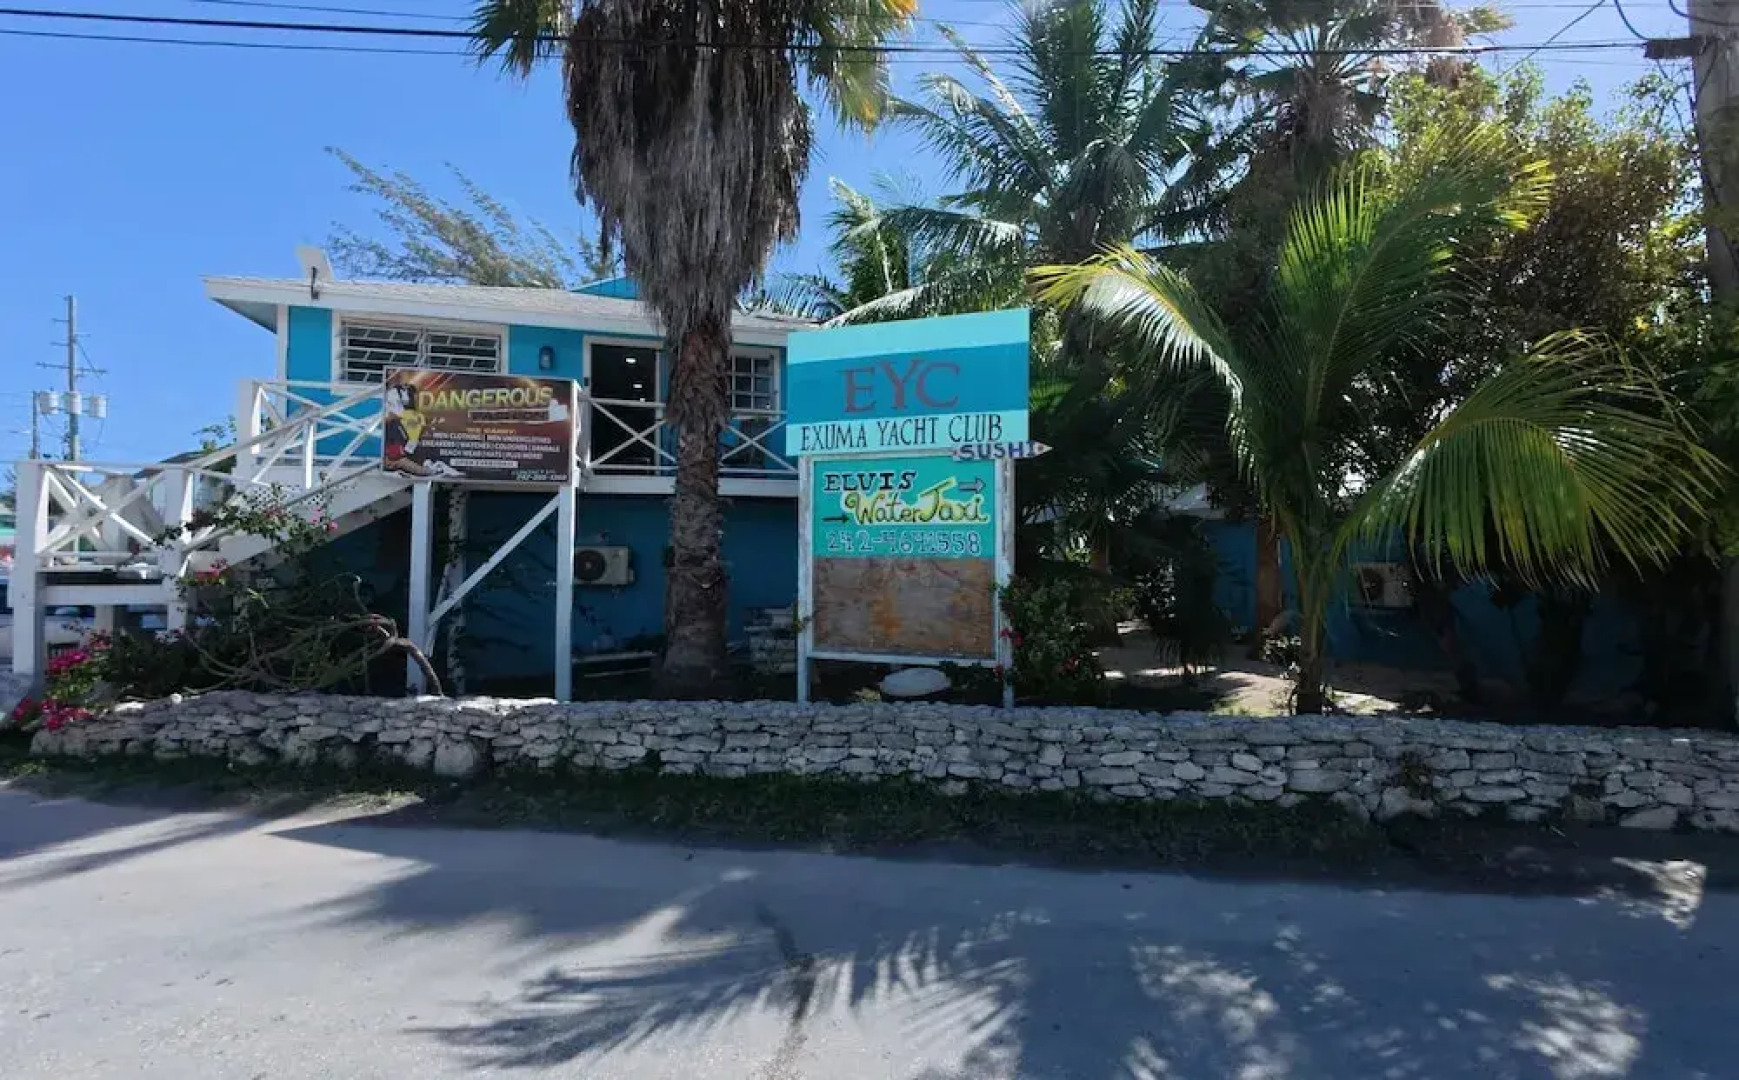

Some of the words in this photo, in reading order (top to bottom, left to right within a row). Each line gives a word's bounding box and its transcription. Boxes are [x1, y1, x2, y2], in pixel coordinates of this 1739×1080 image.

[418, 387, 553, 410] DANGEROUS
[836, 358, 960, 413] EYC
[801, 422, 868, 451] EXUMA
[876, 417, 939, 446] YACHT
[948, 414, 1003, 442] CLUB
[960, 441, 1036, 461] SUSHI
[824, 471, 916, 491] ELVIS
[844, 492, 921, 524] Water
[919, 477, 989, 523] Taxi
